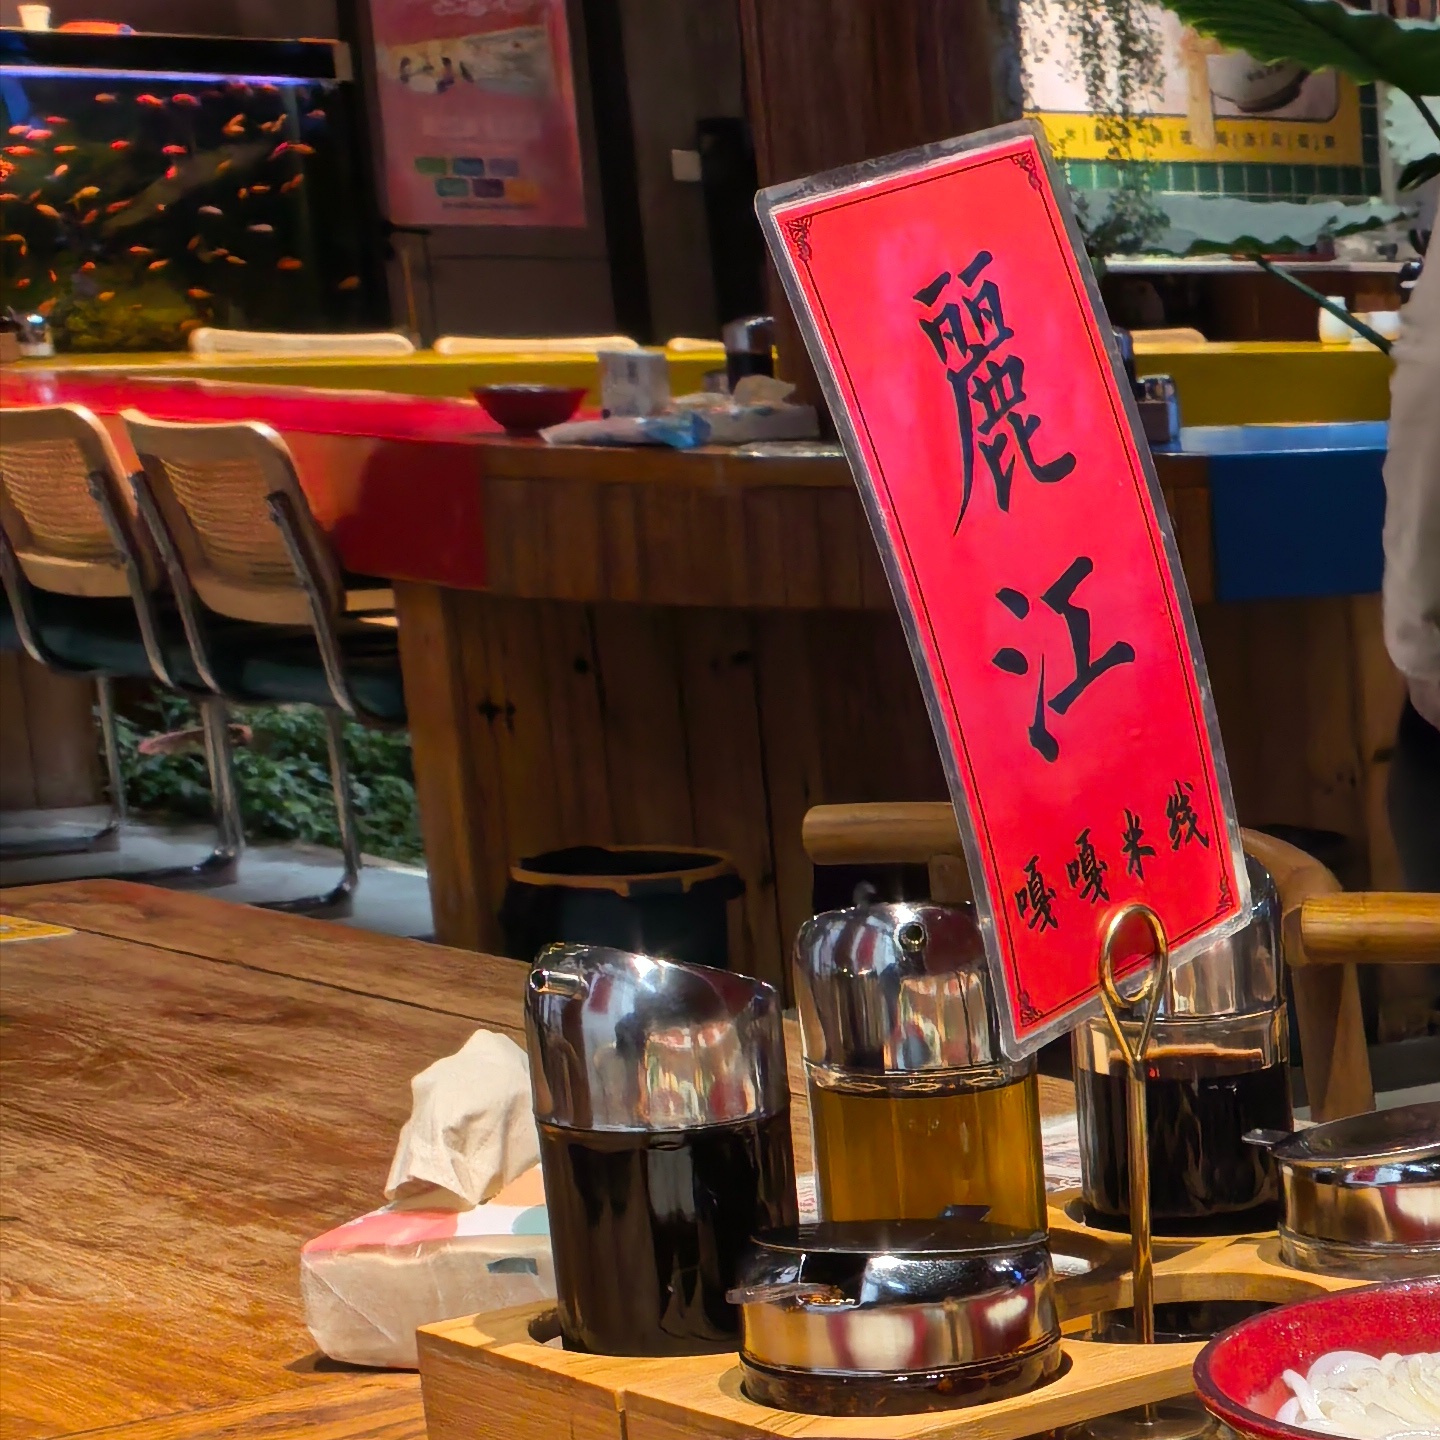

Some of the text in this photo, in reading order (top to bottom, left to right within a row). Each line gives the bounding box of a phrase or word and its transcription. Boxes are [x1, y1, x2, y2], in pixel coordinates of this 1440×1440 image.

[912, 250, 1136, 763] 麗江
[1014, 779, 1209, 933] 嘎嘎米线
